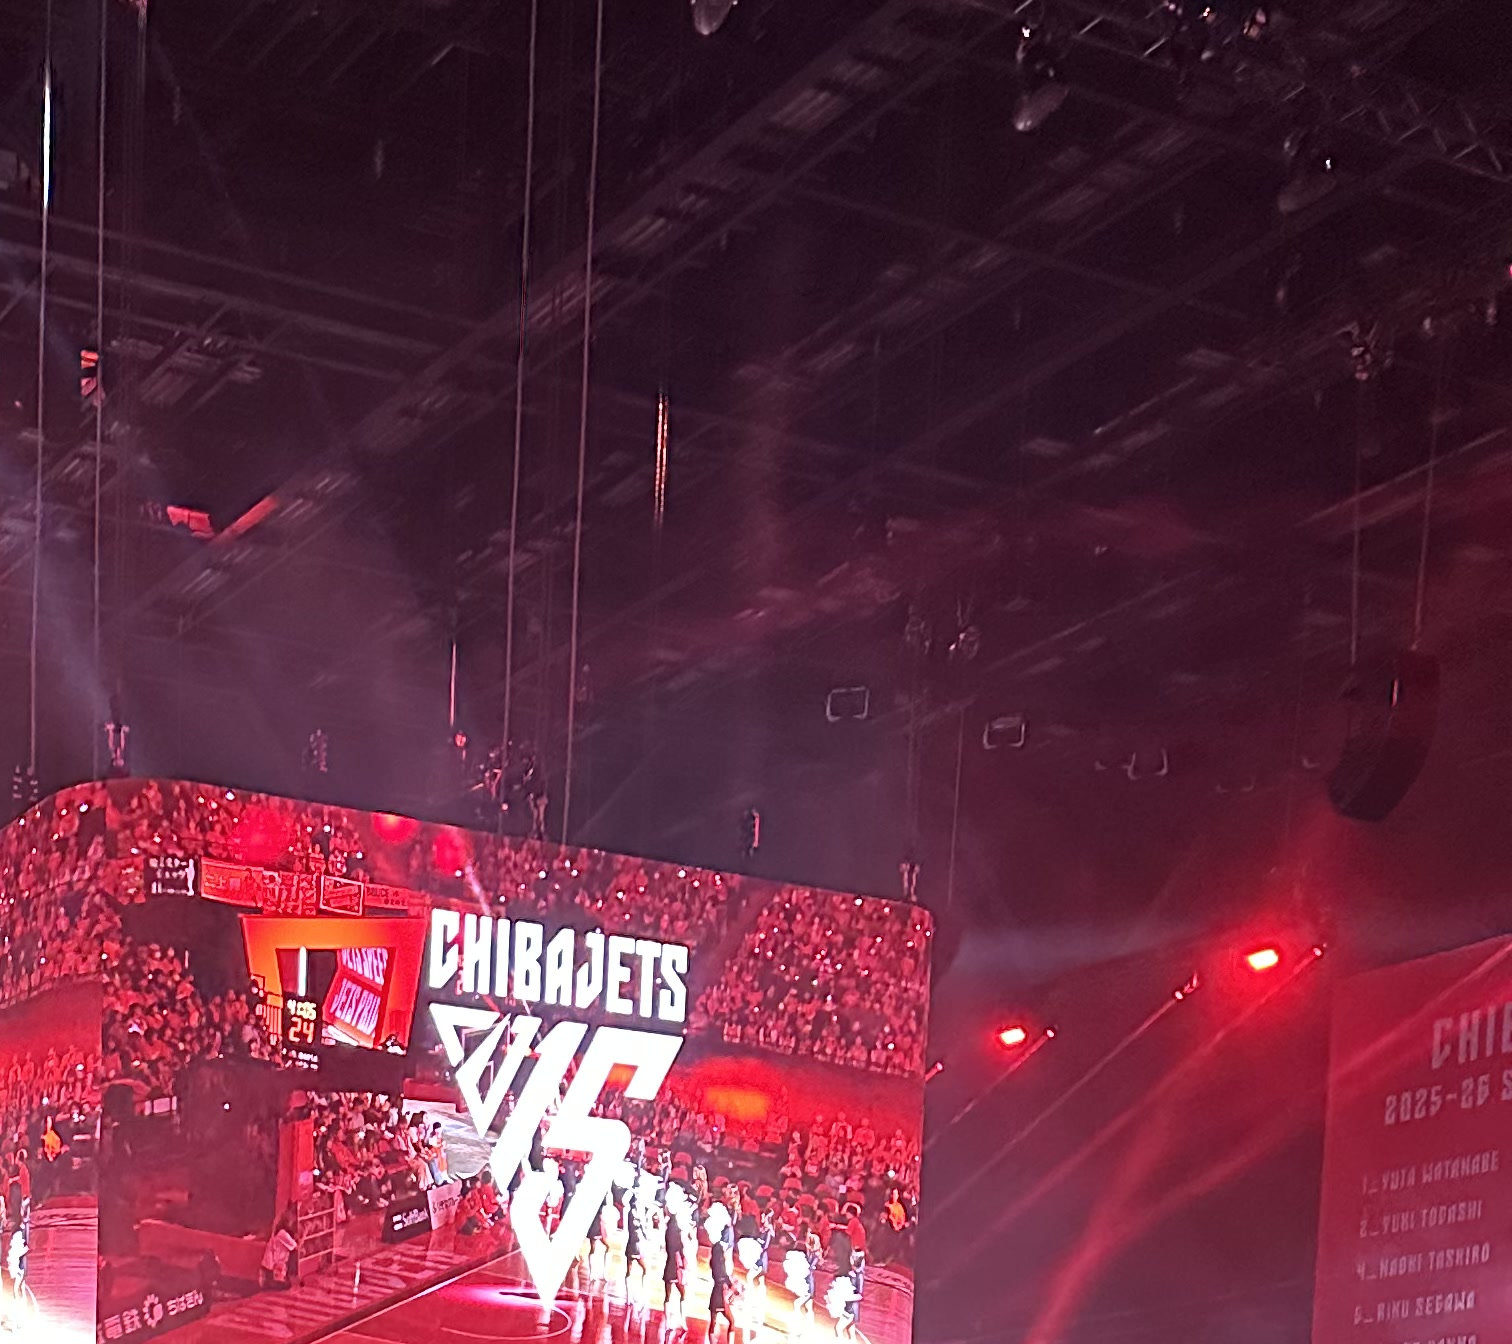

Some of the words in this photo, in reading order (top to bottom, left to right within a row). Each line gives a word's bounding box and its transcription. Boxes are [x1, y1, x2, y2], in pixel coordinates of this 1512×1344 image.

[428, 908, 690, 1023] CHIBAJETS
[289, 1017, 315, 1043] 24
[1384, 1073, 1491, 1126] 2025-26
[1422, 1150, 1500, 1184] WATANABE
